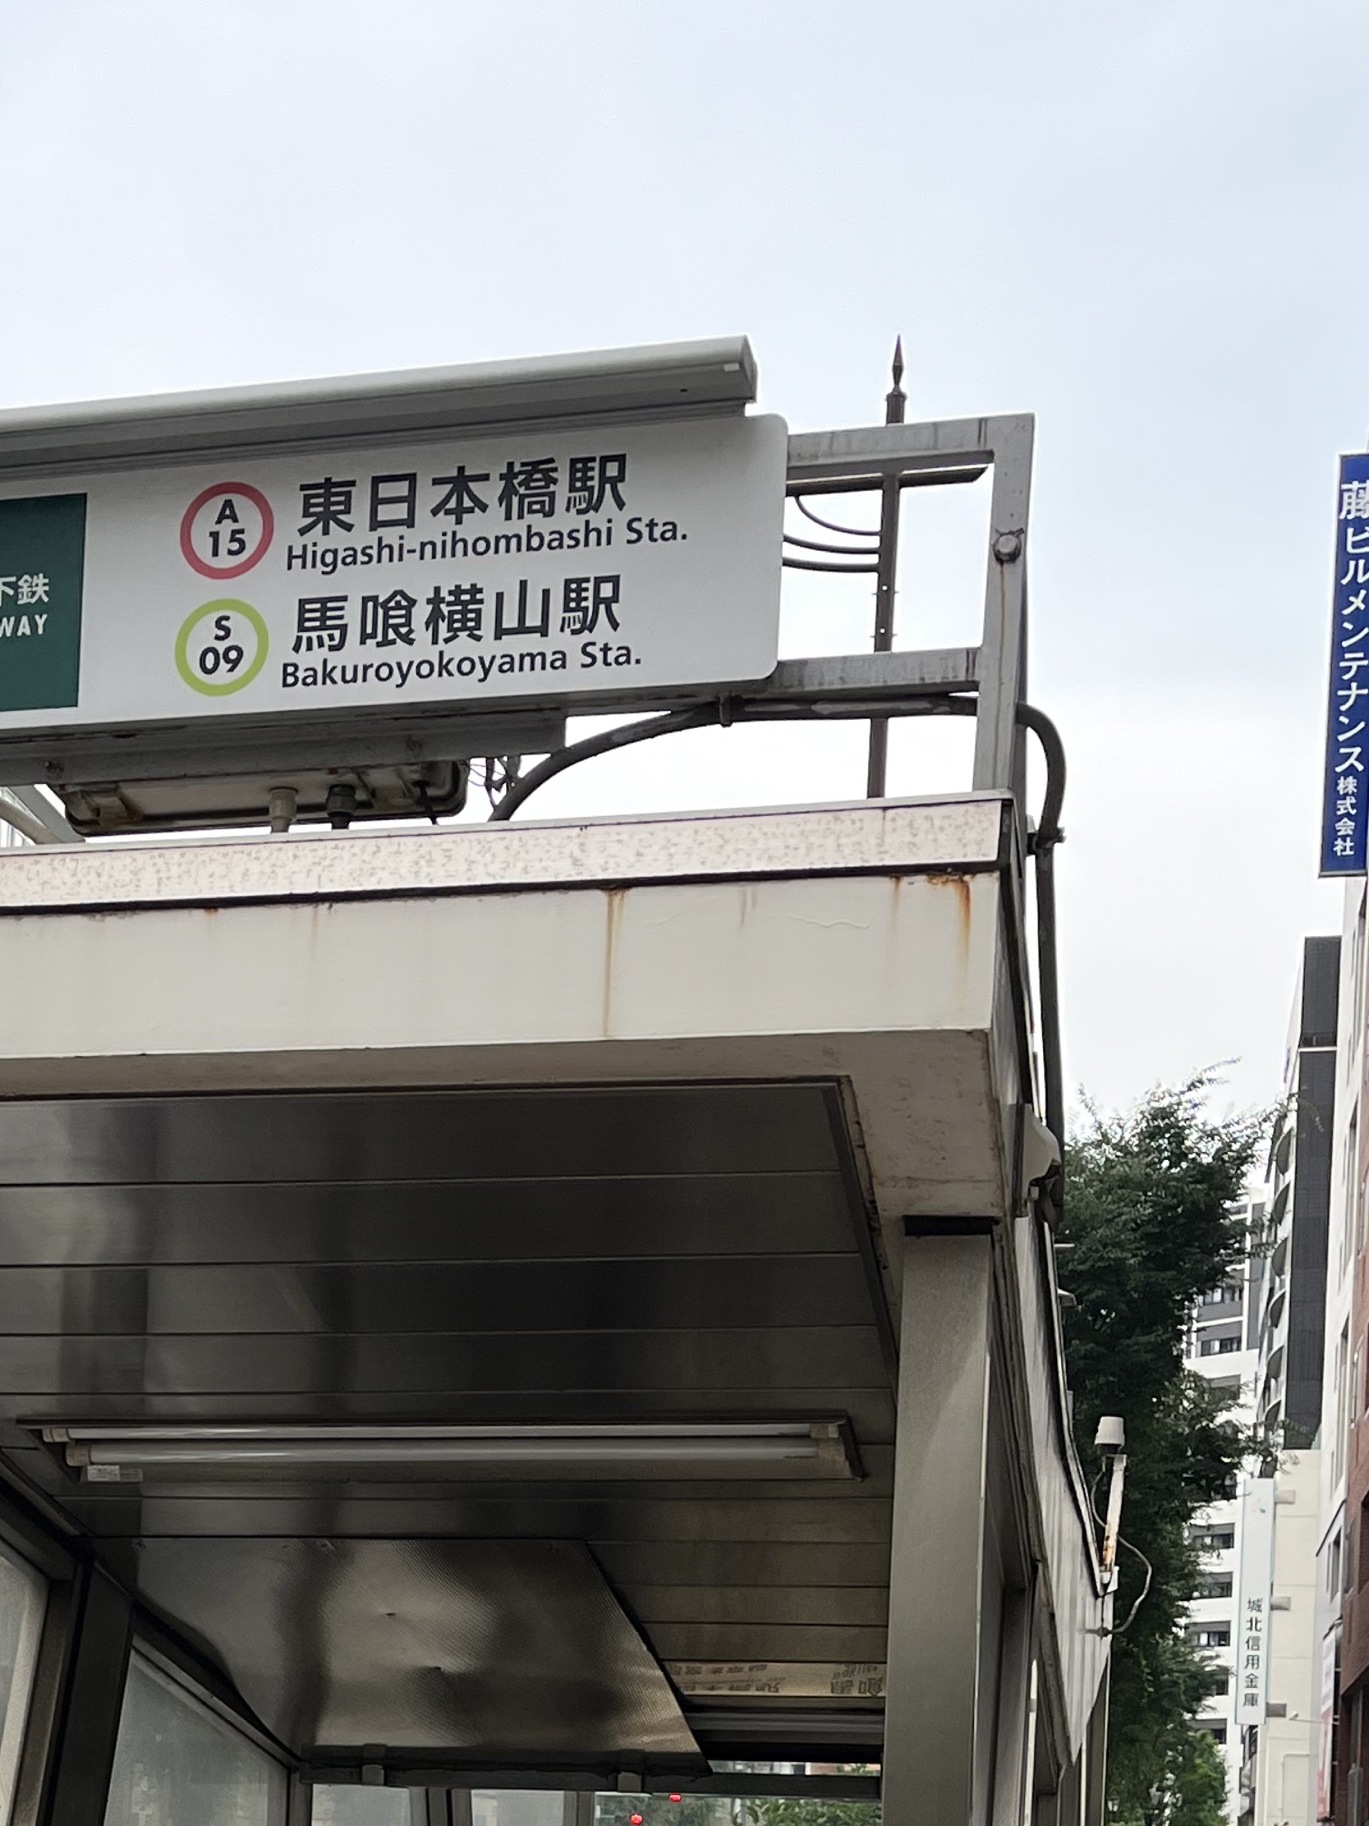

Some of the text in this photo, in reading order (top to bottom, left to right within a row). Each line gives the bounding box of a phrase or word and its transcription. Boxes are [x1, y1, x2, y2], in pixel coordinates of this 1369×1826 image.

[215, 499, 239, 525] A
[297, 453, 627, 537] 東日本橋駅
[207, 528, 247, 558] 15
[286, 516, 688, 575] Higashi-nihombashi Sta.
[214, 615, 232, 642] S
[291, 574, 621, 654] 馬喰横山駅
[199, 644, 244, 675] 09
[281, 640, 642, 688] Bakuroyokoyama Sta.
[1243, 1597, 1264, 1707] 城北信用金庫
